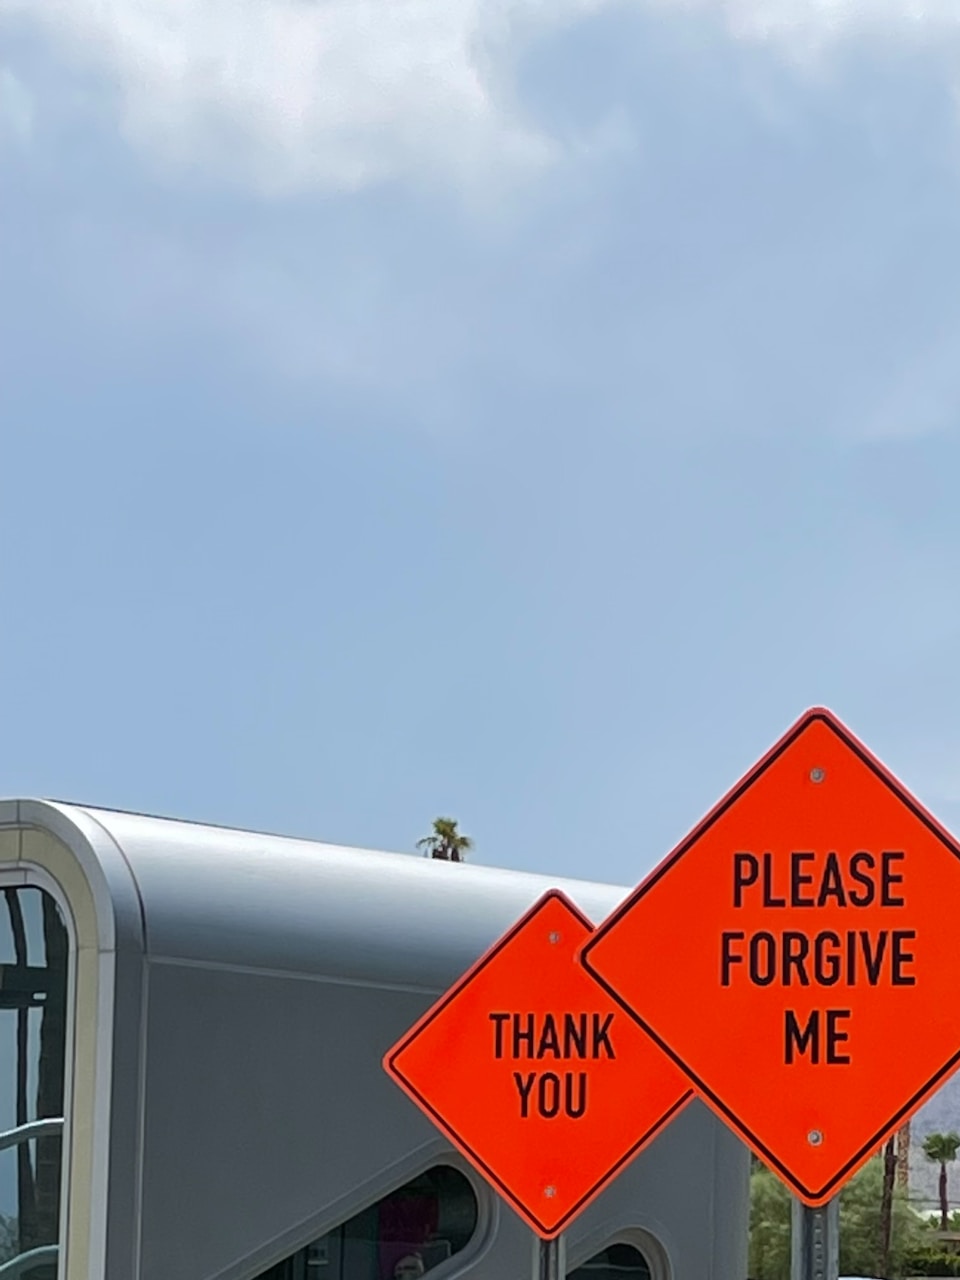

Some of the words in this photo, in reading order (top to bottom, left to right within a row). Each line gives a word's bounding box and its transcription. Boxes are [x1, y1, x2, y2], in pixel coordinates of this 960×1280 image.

[733, 851, 905, 908] PLEASE
[721, 930, 916, 987] FORGIVE
[489, 1013, 615, 1059] THANK
[785, 1009, 851, 1065] ME
[514, 1072, 586, 1119] YOU
